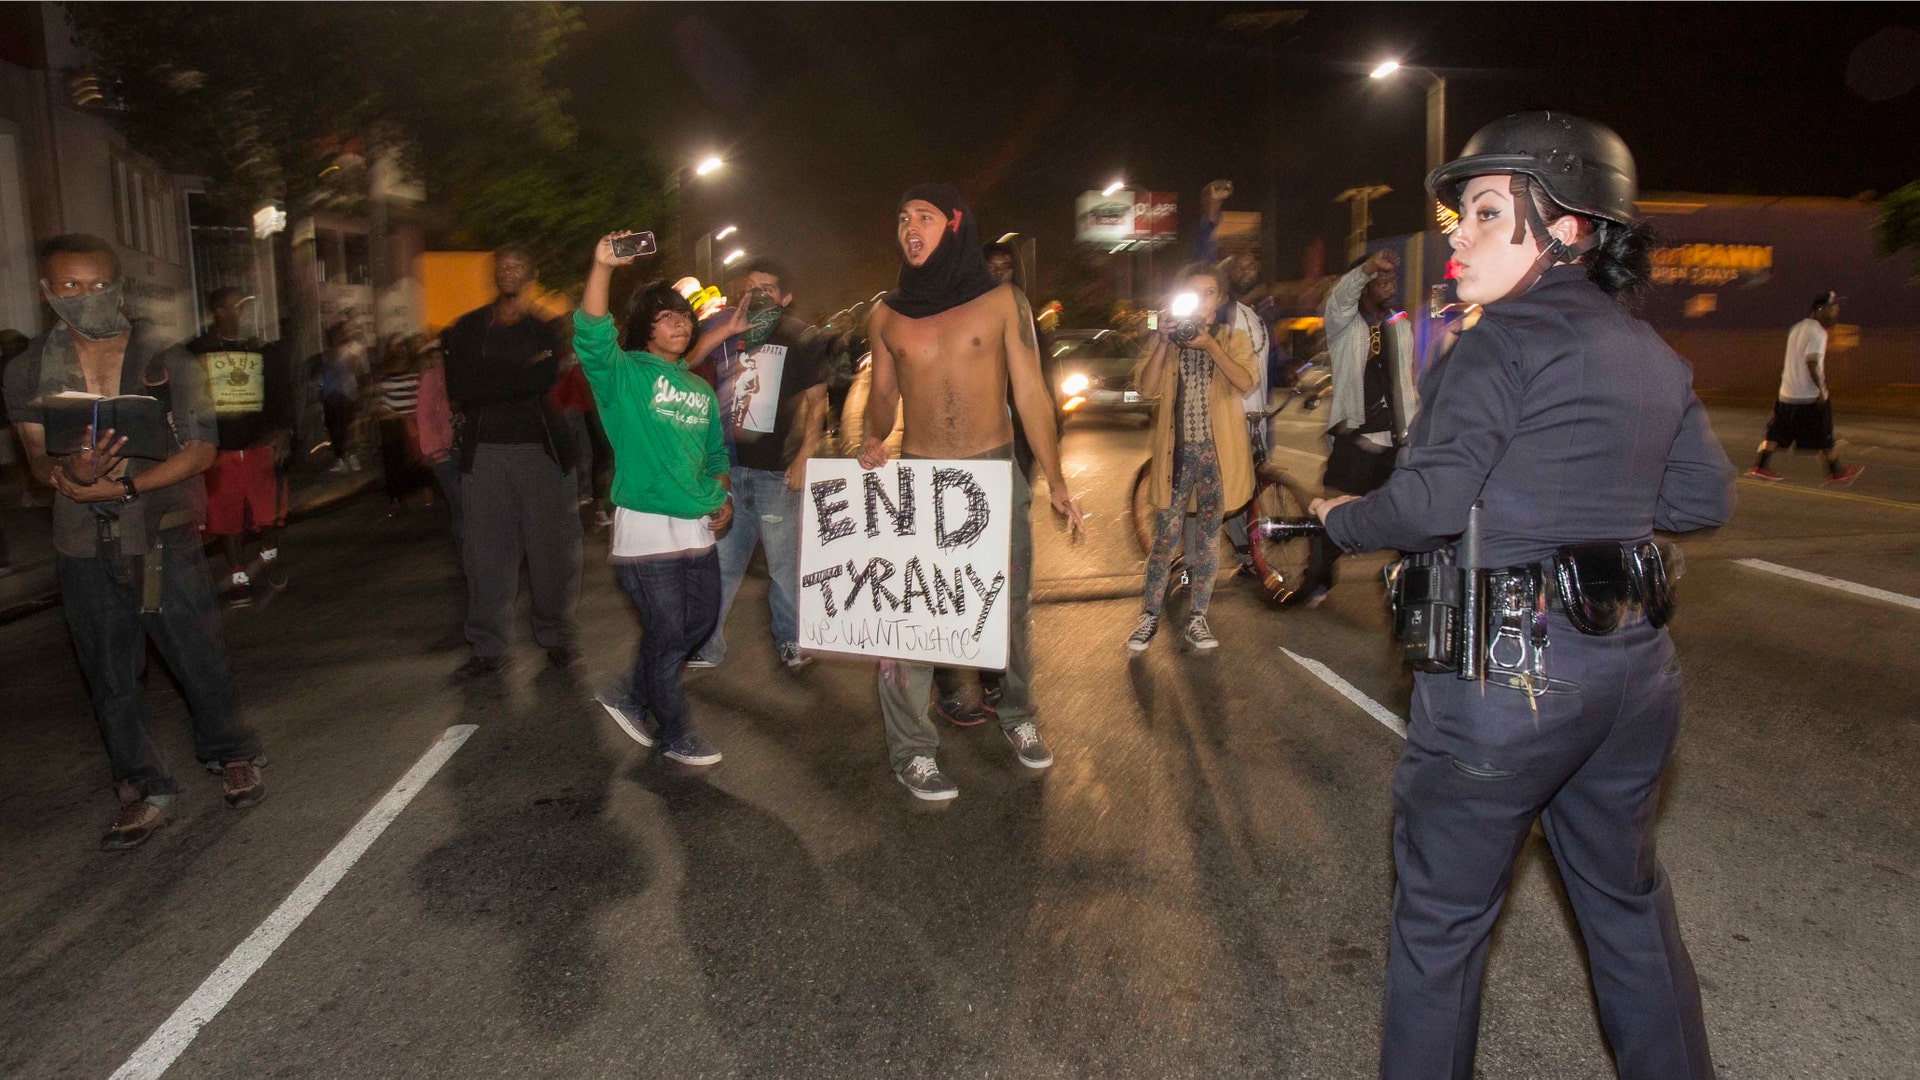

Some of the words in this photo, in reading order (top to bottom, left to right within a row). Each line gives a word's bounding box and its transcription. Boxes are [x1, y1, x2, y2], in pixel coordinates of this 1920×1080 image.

[1651, 267, 1688, 280] OPEN
[1704, 268, 1739, 280] DAYS
[761, 345, 783, 356] APATA
[811, 462, 991, 555] END
[802, 555, 1005, 642] TYRANY
[841, 617, 908, 650] WANT
